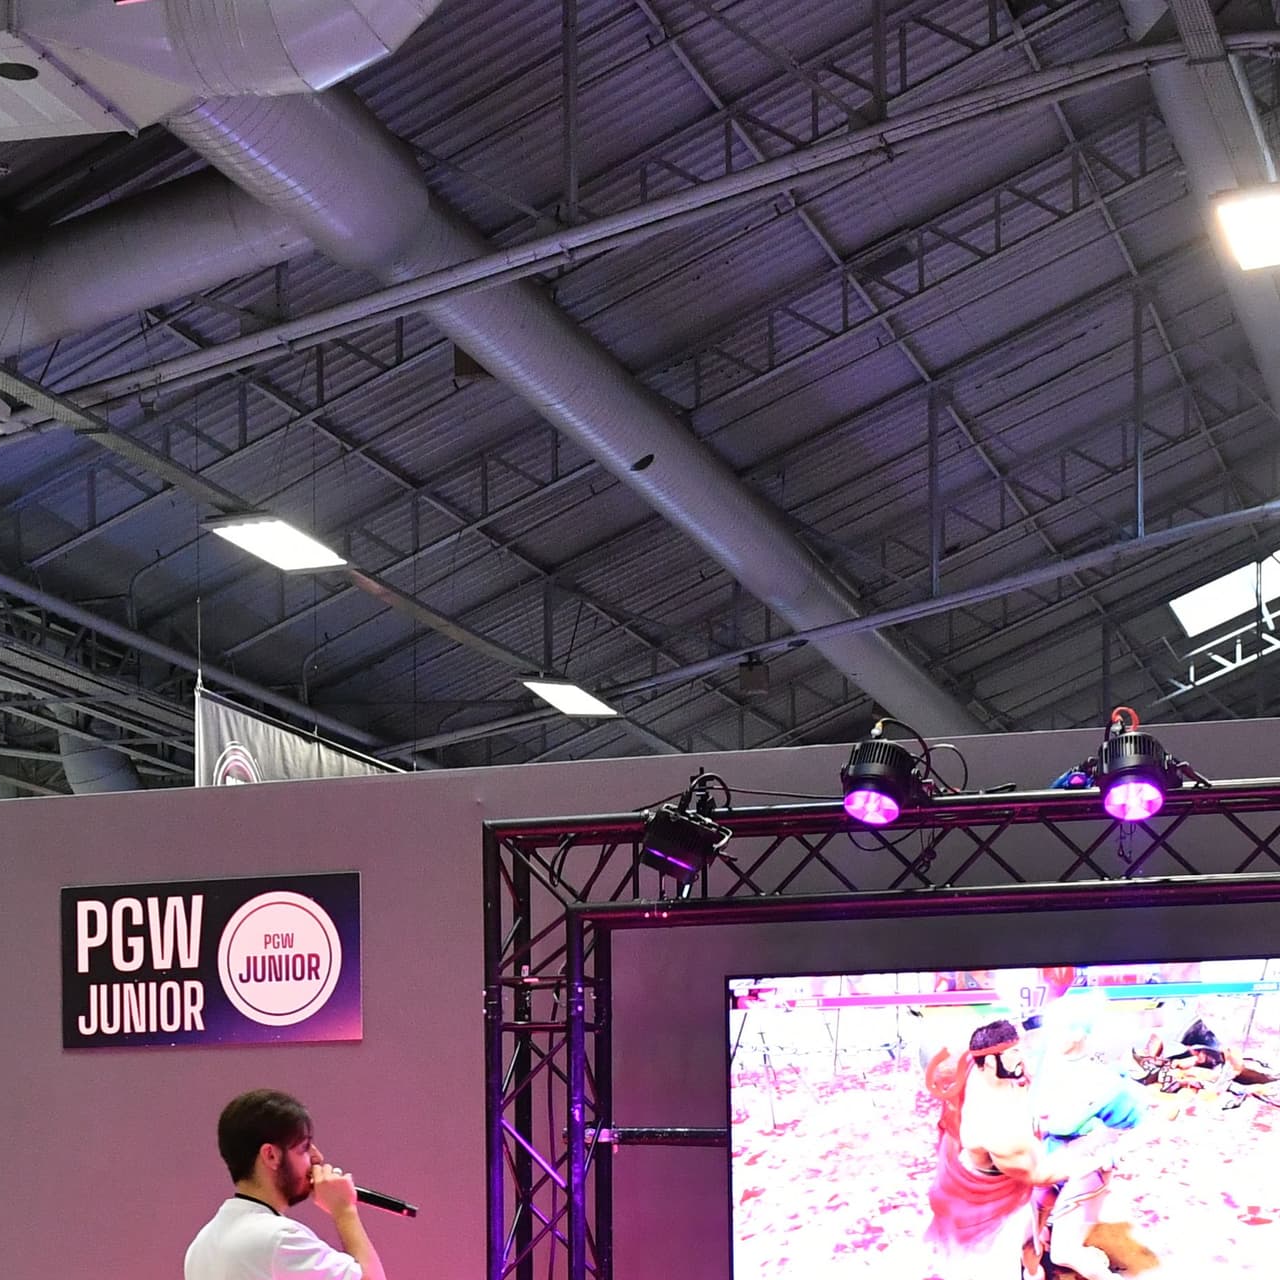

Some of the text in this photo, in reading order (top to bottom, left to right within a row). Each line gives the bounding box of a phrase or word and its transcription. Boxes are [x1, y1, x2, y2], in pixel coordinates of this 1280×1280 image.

[77, 895, 203, 973] PGW
[264, 933, 294, 949] PGW
[239, 953, 320, 983] JUNIOR
[78, 980, 205, 1036] JUNIOR
[1020, 986, 1046, 1007] 97
